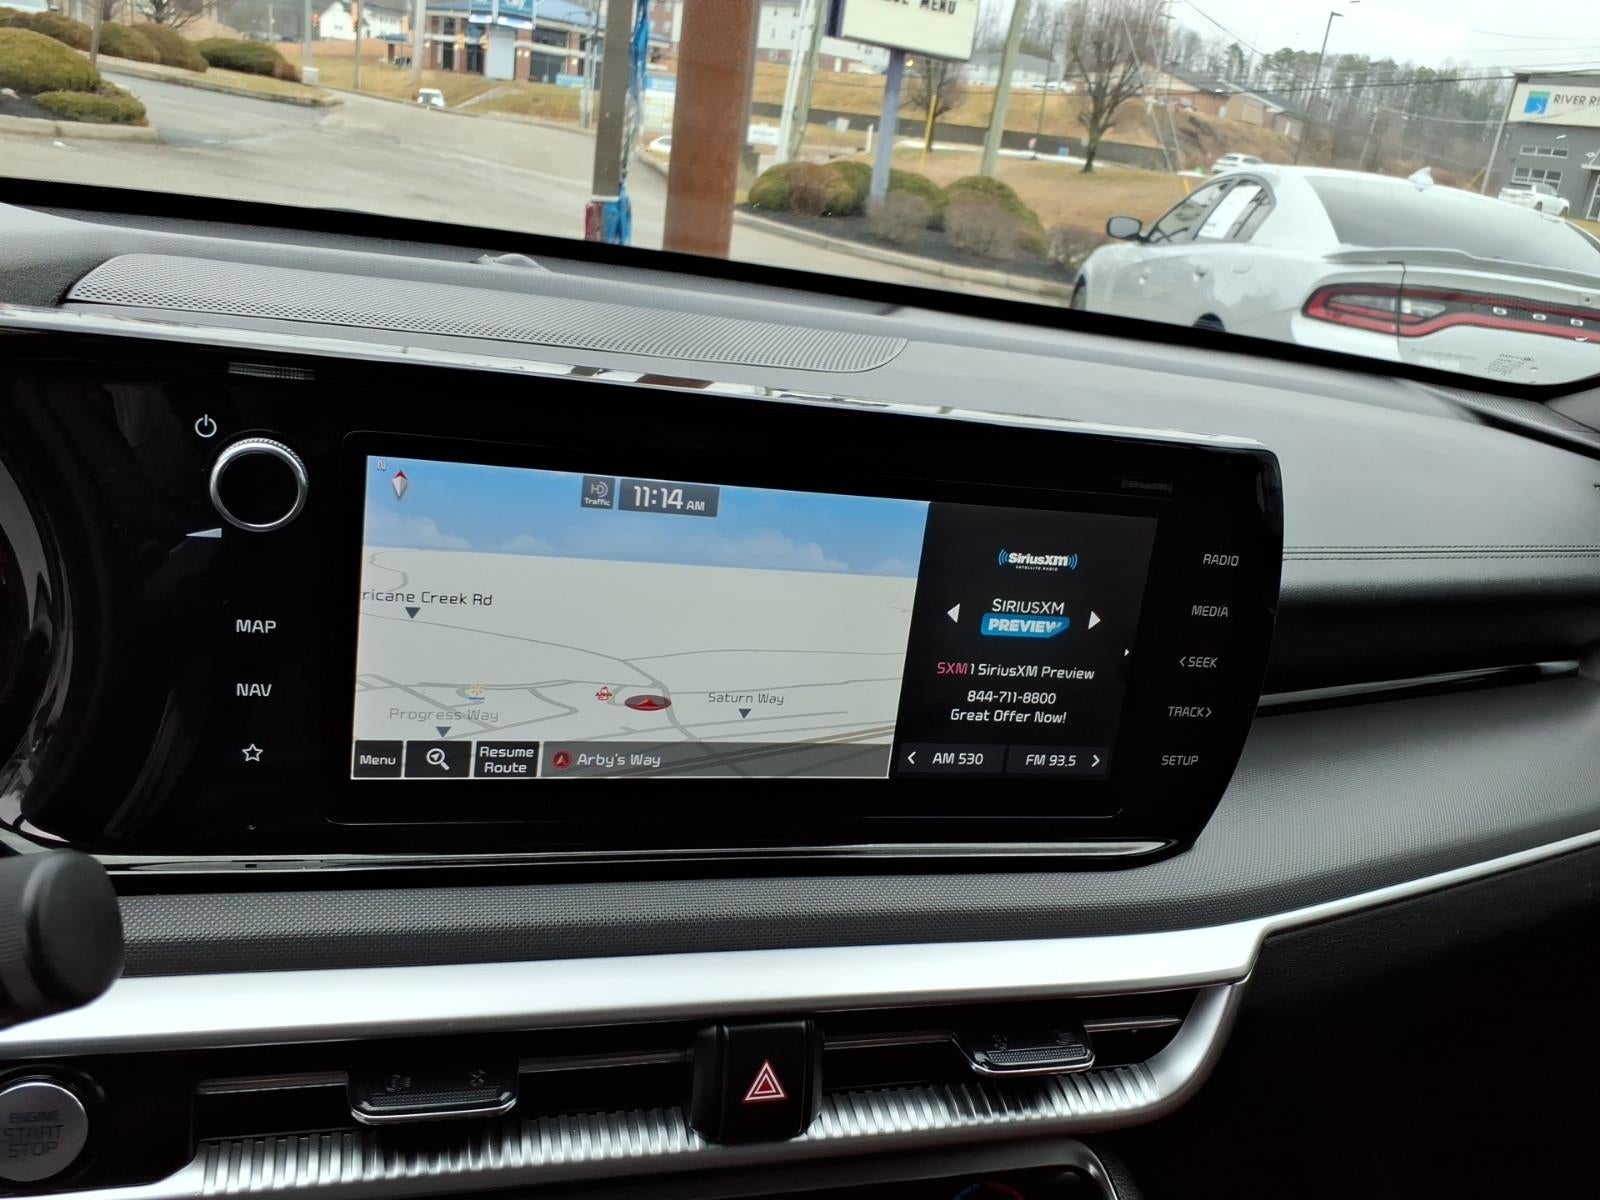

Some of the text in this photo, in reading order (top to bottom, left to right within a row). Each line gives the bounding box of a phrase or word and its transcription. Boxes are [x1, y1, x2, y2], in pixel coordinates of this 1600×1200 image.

[1553, 94, 1586, 105] RIVER
[584, 497, 611, 507] Traffic
[633, 485, 706, 512] 11:14 AM
[1202, 553, 1240, 568] RADIO
[362, 589, 493, 606] ricane Creek Rd
[1191, 604, 1229, 618] MEDIA
[235, 618, 277, 634] MAP
[987, 617, 1062, 633] PREVIEW
[1187, 655, 1218, 669] SEEK
[936, 661, 968, 674] SXM
[977, 663, 1038, 678] SiriusXM
[1040, 665, 1095, 680] Preview
[235, 682, 272, 697] NAV
[707, 691, 784, 706] Saturn Way
[967, 690, 1057, 705] 844-711-8800
[388, 707, 499, 723] Progress Way
[950, 708, 1067, 724] Great Offer Now!
[1168, 705, 1205, 719] TRACK
[479, 746, 534, 758] Resume
[932, 752, 984, 765] AM 530
[359, 754, 396, 766] Menu
[484, 761, 527, 773] Route
[576, 752, 662, 768] Arby's Way
[1025, 754, 1077, 767] FM 93.5
[1161, 754, 1199, 767] SETUP
[3, 1124, 65, 1139] START
[7, 1141, 58, 1158] STOP
